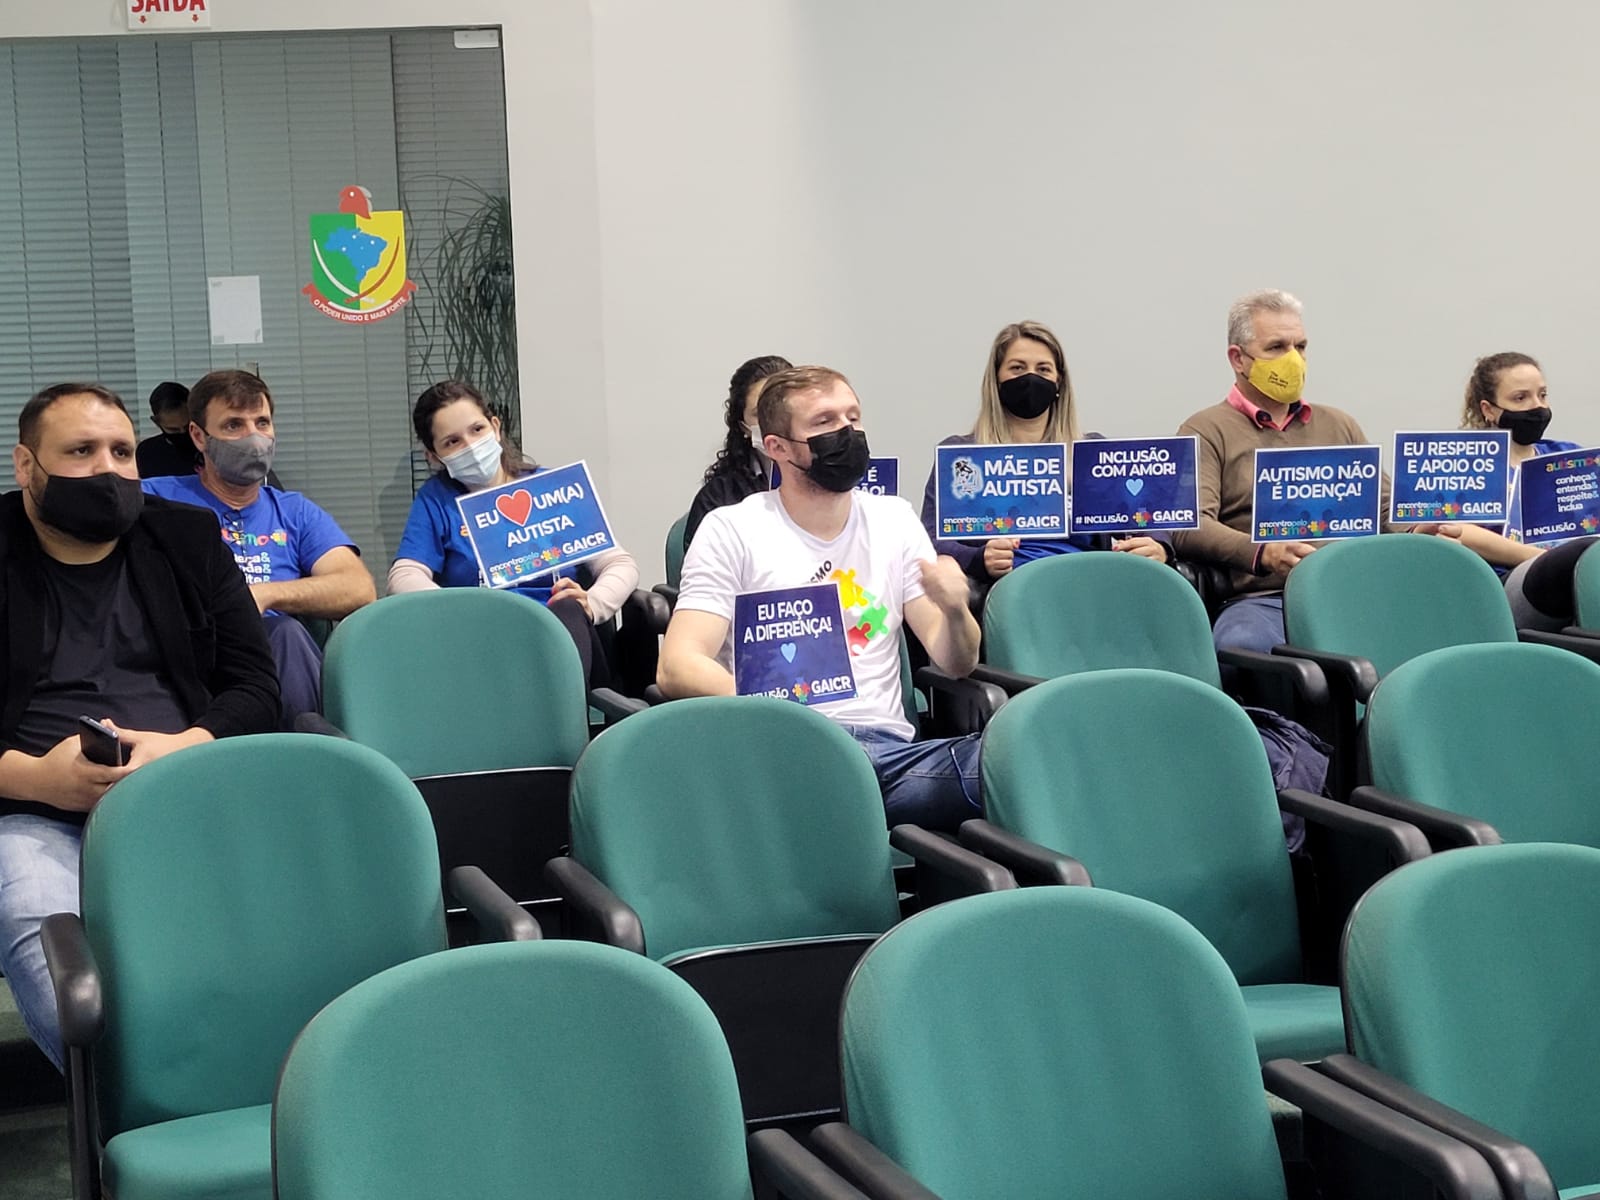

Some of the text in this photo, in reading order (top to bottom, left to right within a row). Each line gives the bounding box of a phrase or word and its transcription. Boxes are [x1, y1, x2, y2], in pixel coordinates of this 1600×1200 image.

[318, 304, 341, 319] PODER
[370, 311, 387, 320] MAIS
[387, 296, 407, 315] FORTE
[1099, 447, 1170, 464] INCLUSÃO
[1403, 440, 1500, 456] EU RESPEITO
[984, 454, 1060, 476] MÃE DE
[1092, 462, 1176, 478] COM AMOR!
[1258, 460, 1377, 483] AUTISMO NÃO
[1407, 458, 1495, 474] E APOIO OS
[868, 466, 878, 482] É
[982, 479, 1063, 497] AUTISTA
[1272, 482, 1362, 501] É DOENÇA!
[1414, 476, 1486, 491] AUTISTAS
[475, 483, 585, 529] EU UM(A)
[1462, 502, 1503, 514] GAICR
[1558, 503, 1584, 513] inclua
[1015, 515, 1060, 528] GAICR
[1084, 513, 1129, 524] INCLUSÃO
[1152, 510, 1194, 522] GAICR
[507, 515, 576, 548] AUTISTA
[1329, 518, 1372, 531] GAICR
[1533, 522, 1577, 536] INCLUSÃO
[562, 532, 608, 555] GAICR
[757, 599, 813, 621] EU FAÇO
[743, 616, 833, 644] A DIFERENÇA!
[811, 676, 851, 694] GAICR
